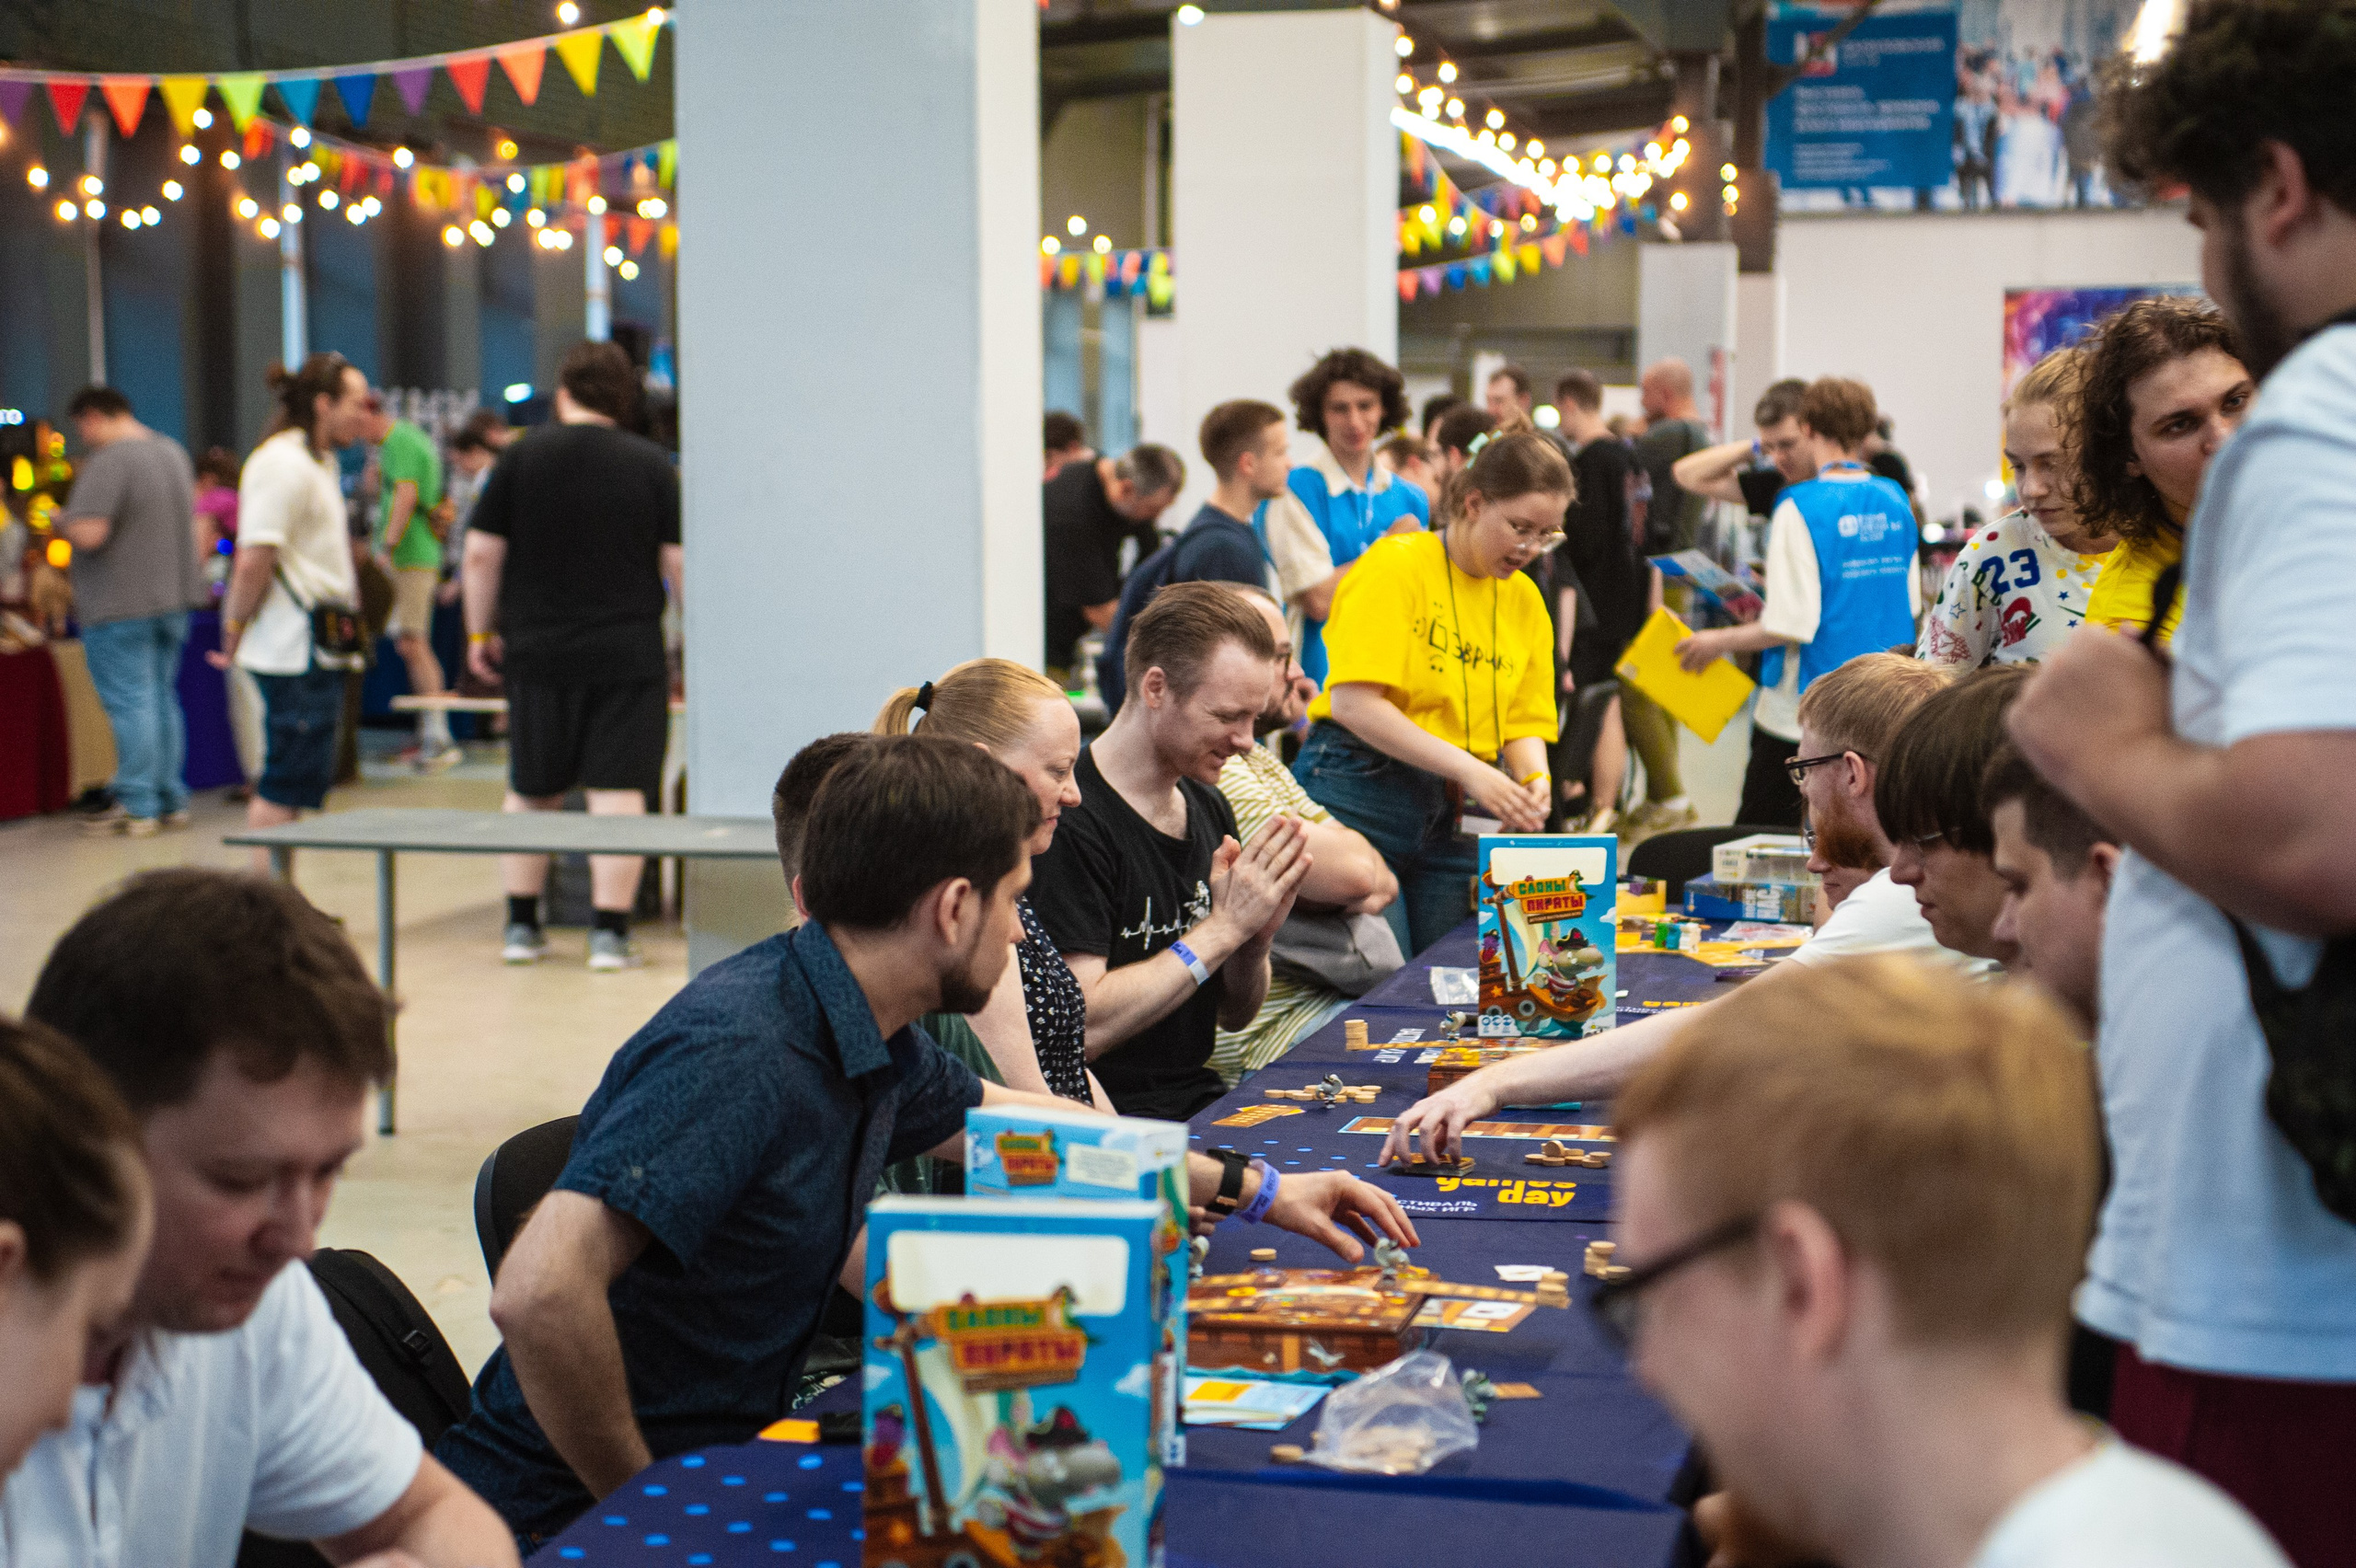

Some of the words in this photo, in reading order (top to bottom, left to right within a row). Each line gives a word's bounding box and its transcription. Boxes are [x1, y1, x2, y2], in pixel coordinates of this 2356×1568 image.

[1981, 548, 2041, 594] 23
[1519, 880, 1566, 895] СЛОНЫ
[1527, 895, 1584, 912] ПИРАТЫ
[1497, 1181, 1576, 1207] day
[1396, 1198, 1478, 1208] СТИВАЛЬ
